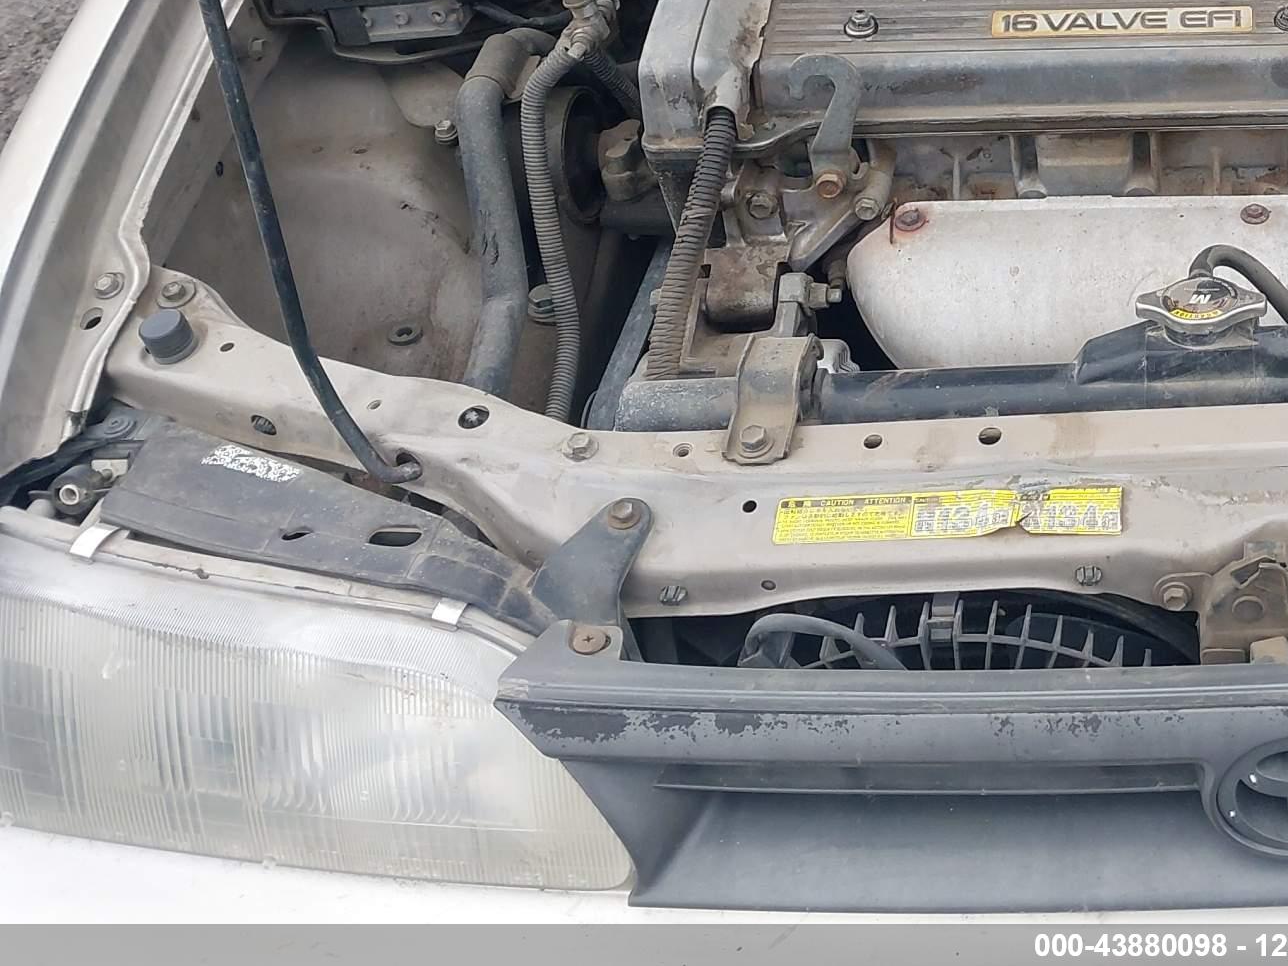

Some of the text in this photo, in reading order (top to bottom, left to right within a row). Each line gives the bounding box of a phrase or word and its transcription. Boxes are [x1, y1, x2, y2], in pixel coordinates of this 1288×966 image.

[1179, 9, 1242, 28] EFI
[820, 499, 855, 507] CAUTION
[863, 497, 906, 505] ATTENTION
